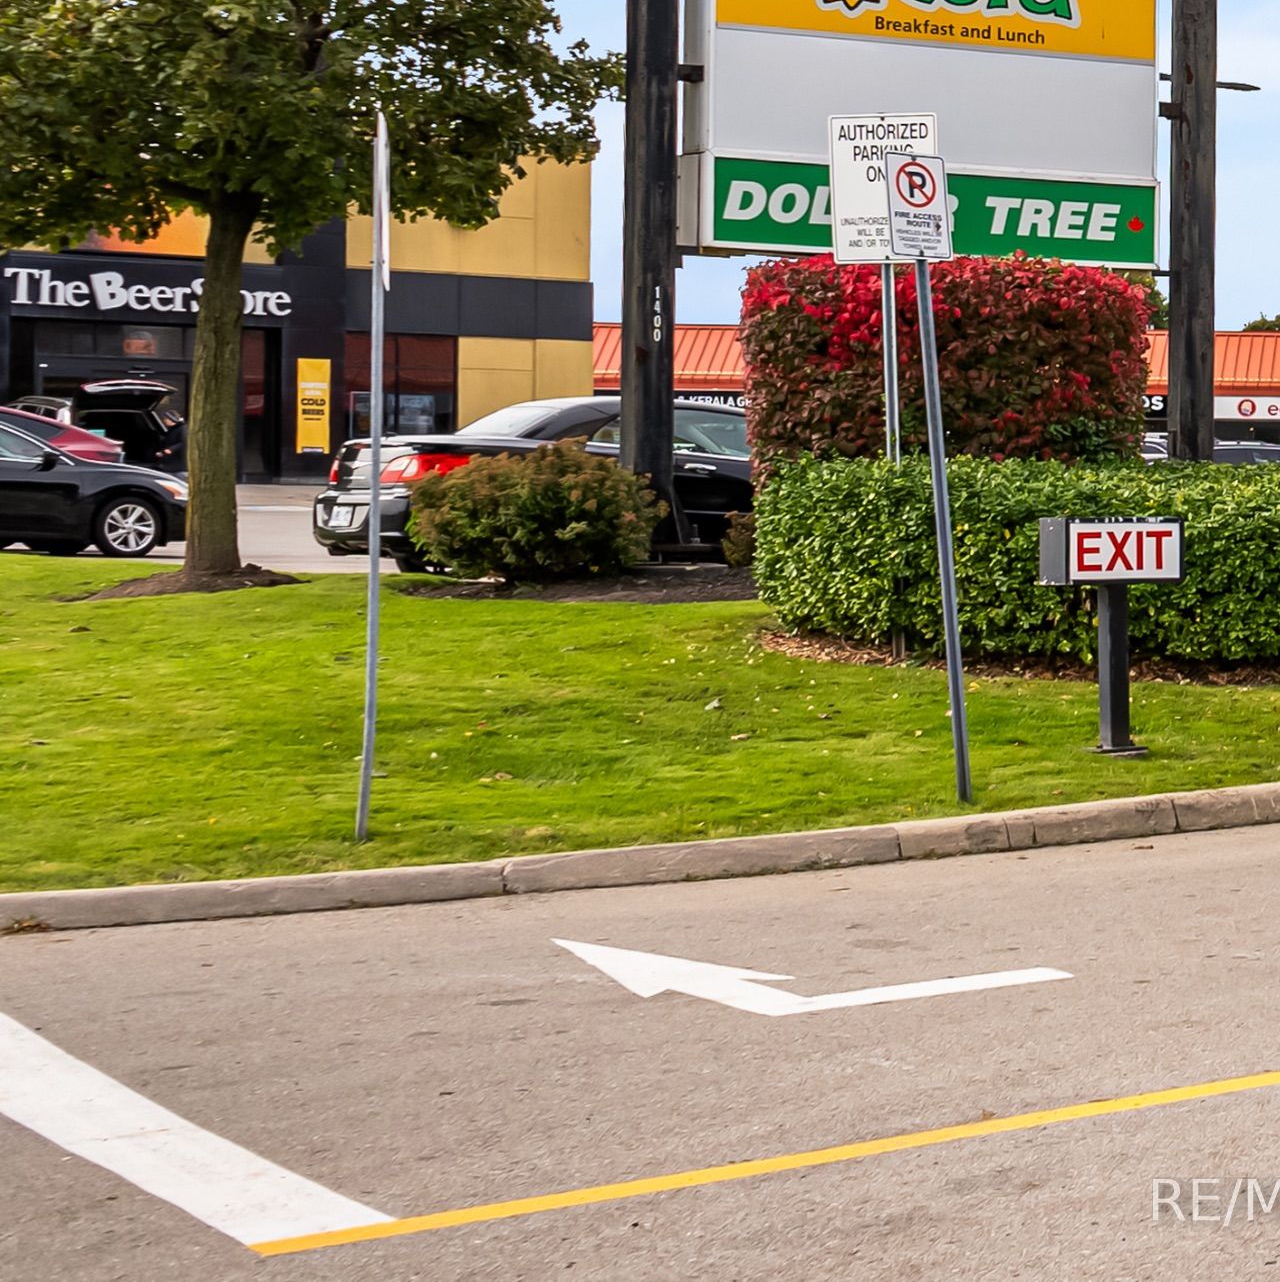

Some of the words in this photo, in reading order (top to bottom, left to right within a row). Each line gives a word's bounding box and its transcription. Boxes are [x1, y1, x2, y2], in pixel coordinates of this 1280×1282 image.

[875, 15, 955, 39] Breakfast
[960, 24, 991, 41] and
[997, 26, 1045, 45] Lunch
[838, 123, 928, 140] AUTHORIZED
[840, 216, 889, 226] UNAUTHORIZE
[985, 196, 1122, 241] TREE
[4, 267, 90, 307] The
[90, 271, 190, 311] Beer
[653, 285, 661, 342] 1400
[1077, 531, 1172, 571] EXIT
